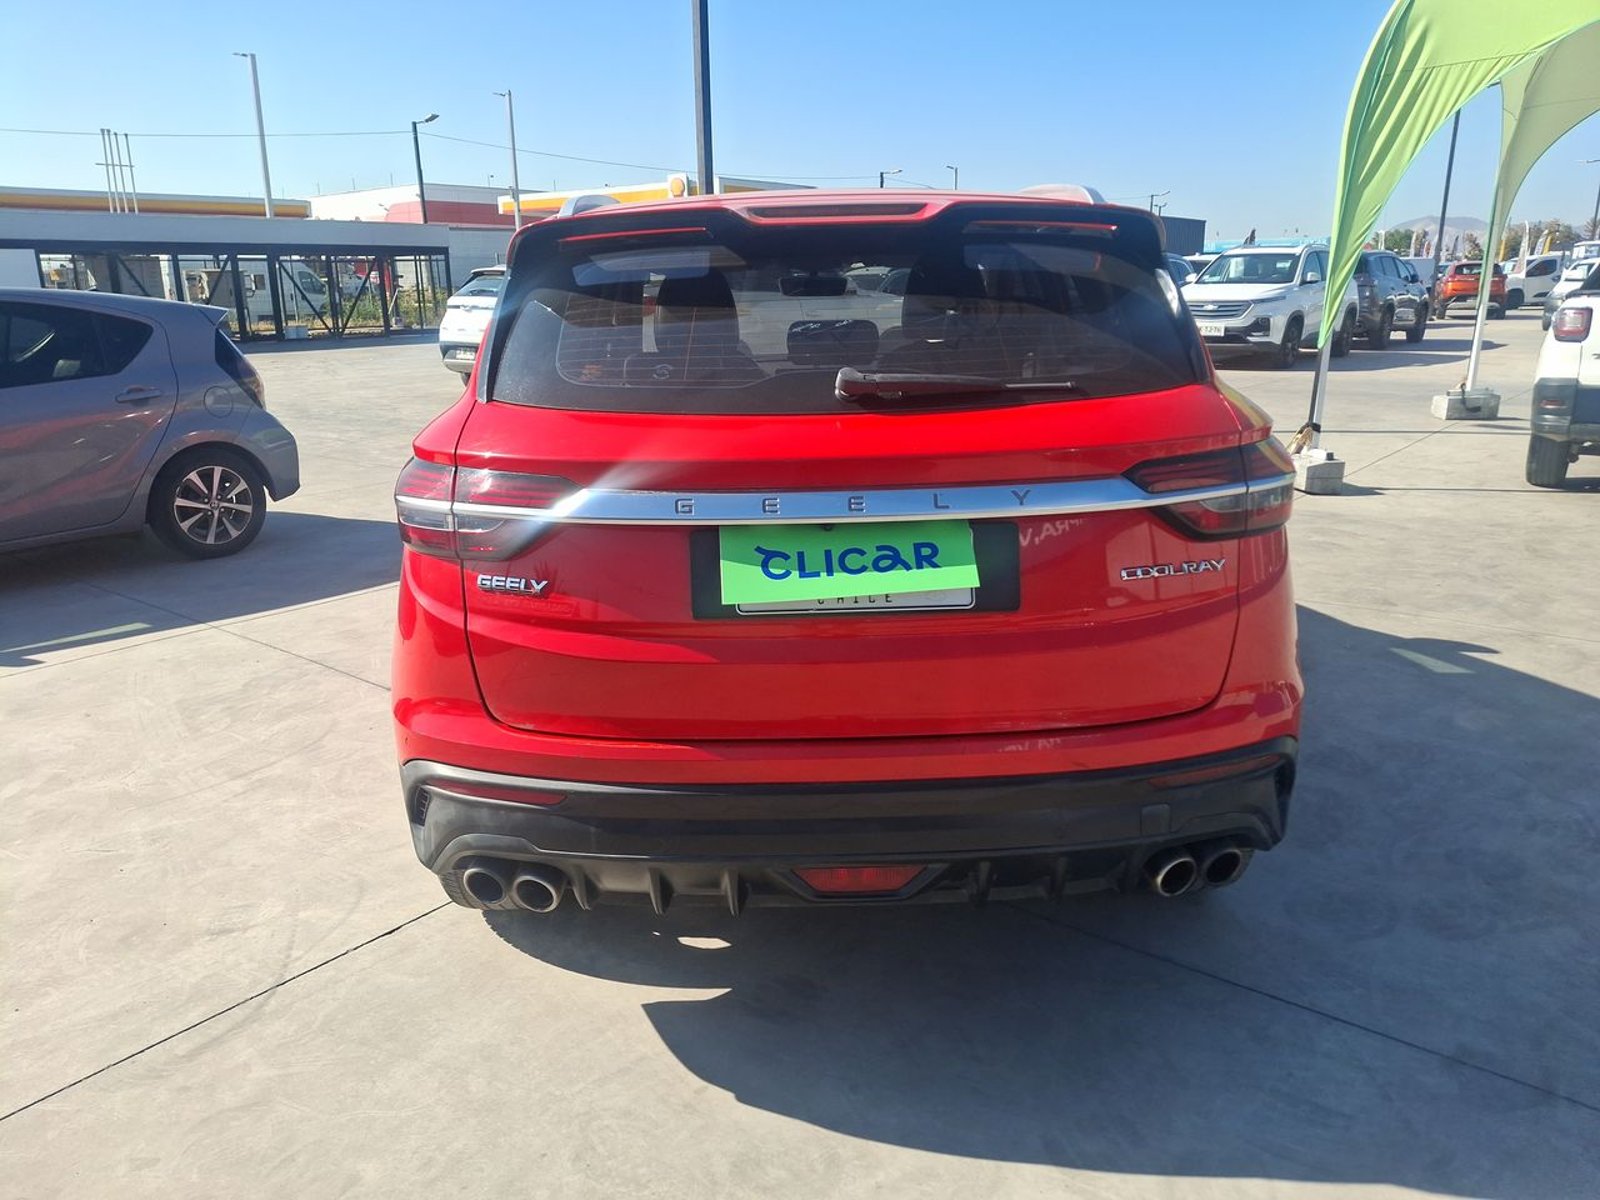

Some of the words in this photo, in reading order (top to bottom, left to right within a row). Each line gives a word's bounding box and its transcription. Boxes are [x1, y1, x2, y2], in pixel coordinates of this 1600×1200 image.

[675, 489, 1031, 514] GEELY
[1120, 559, 1226, 581] COOLRAY
[477, 574, 548, 594] GEELY
